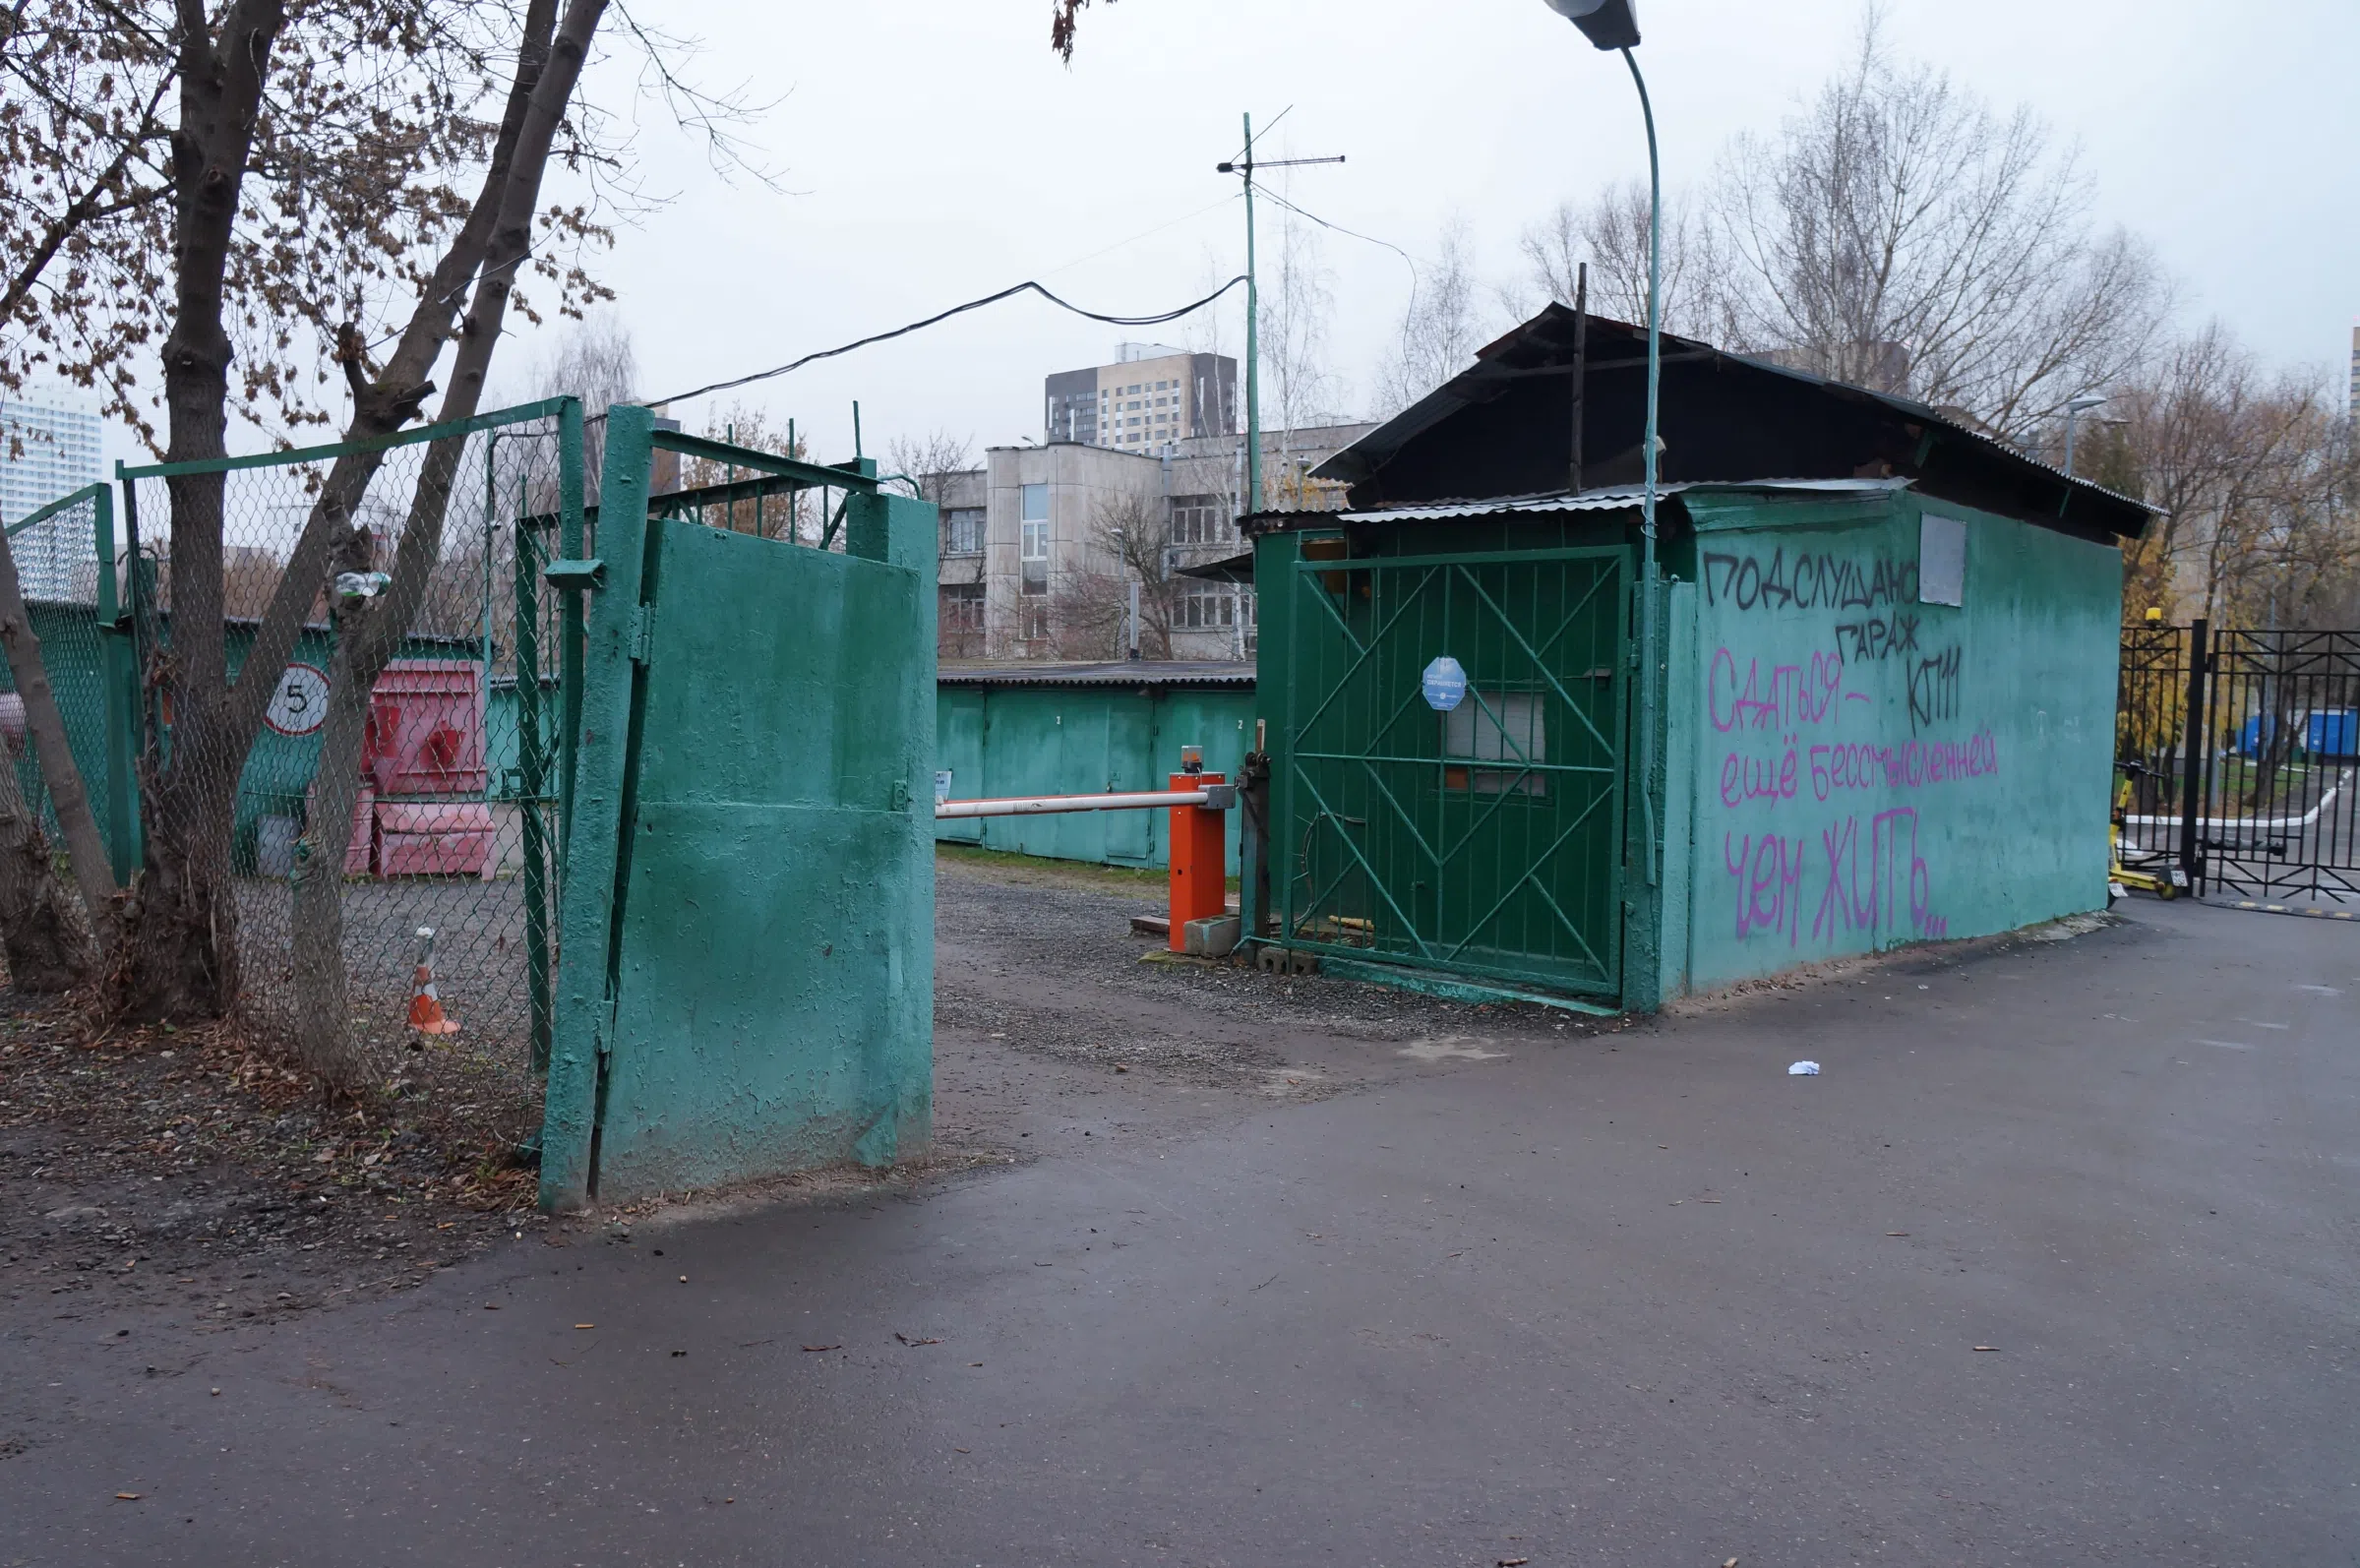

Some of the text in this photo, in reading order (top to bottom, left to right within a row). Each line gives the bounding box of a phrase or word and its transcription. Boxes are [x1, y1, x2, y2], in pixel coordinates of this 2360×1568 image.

[1703, 546, 1919, 611] ПОДСЛУШАНО
[1835, 611, 1919, 666] ГАРАЖ
[287, 685, 307, 713] 5
[1238, 719, 1243, 730] 2
